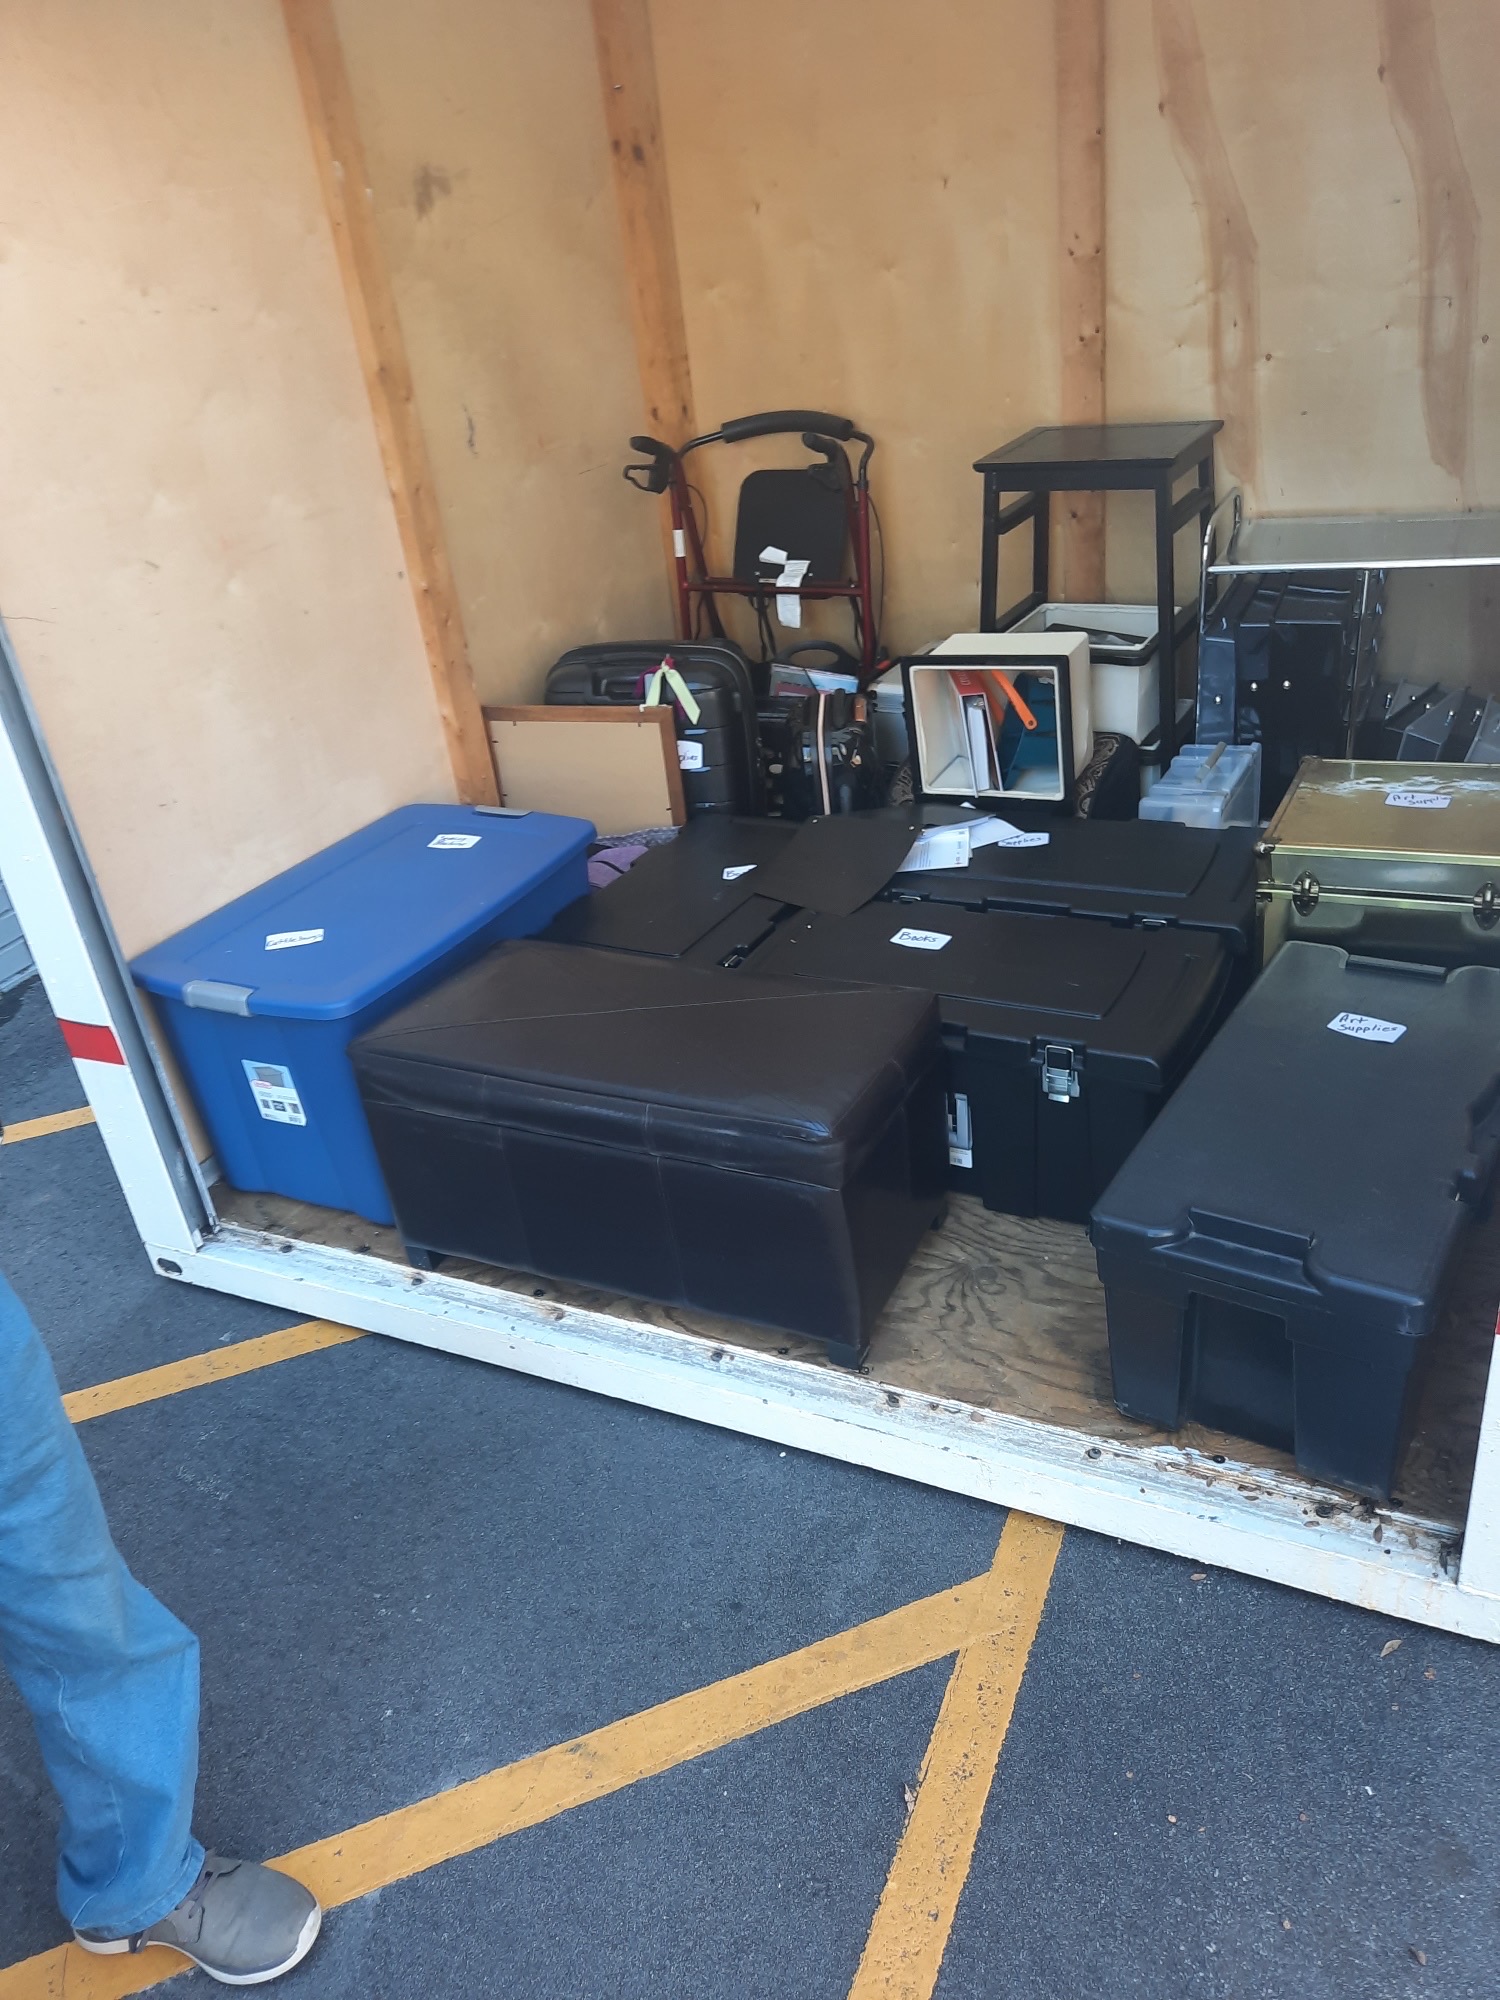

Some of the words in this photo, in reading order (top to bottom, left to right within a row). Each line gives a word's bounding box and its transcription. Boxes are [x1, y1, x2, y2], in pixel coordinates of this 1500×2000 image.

[1392, 794, 1416, 802] Art
[898, 931, 939, 943] Books
[1338, 1014, 1369, 1024] Art
[1337, 1024, 1398, 1034] Supplies
